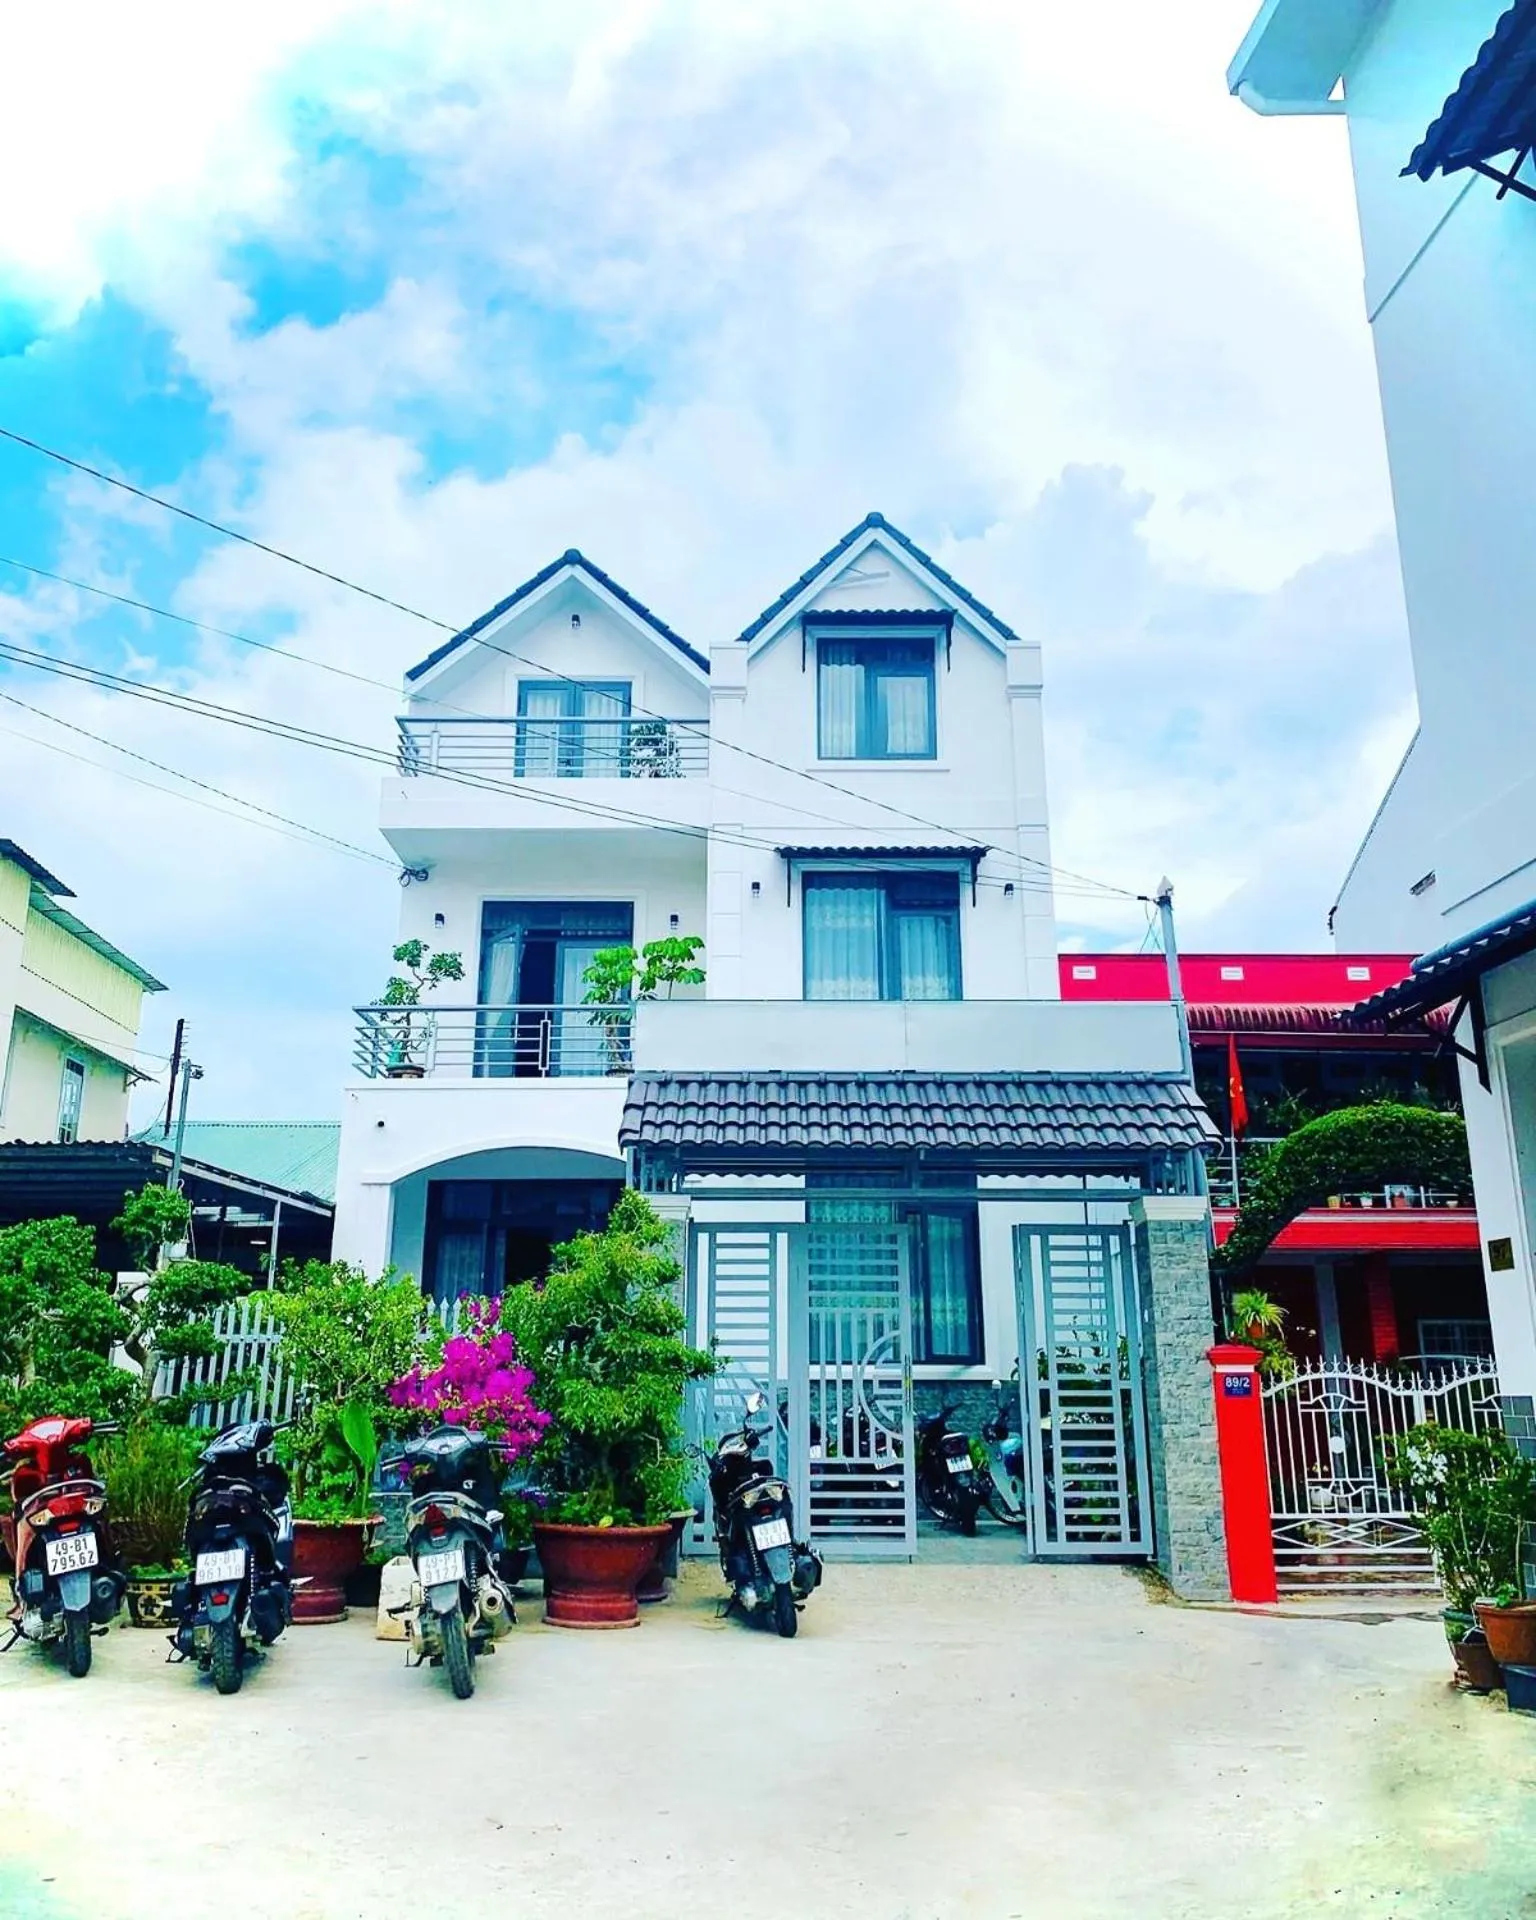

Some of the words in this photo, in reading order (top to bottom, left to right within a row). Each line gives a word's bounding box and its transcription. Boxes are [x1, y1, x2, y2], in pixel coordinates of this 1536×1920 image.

[1225, 1376, 1250, 1388] 89/2
[55, 1538, 88, 1555] 49-B1
[51, 1550, 95, 1572] 795.62
